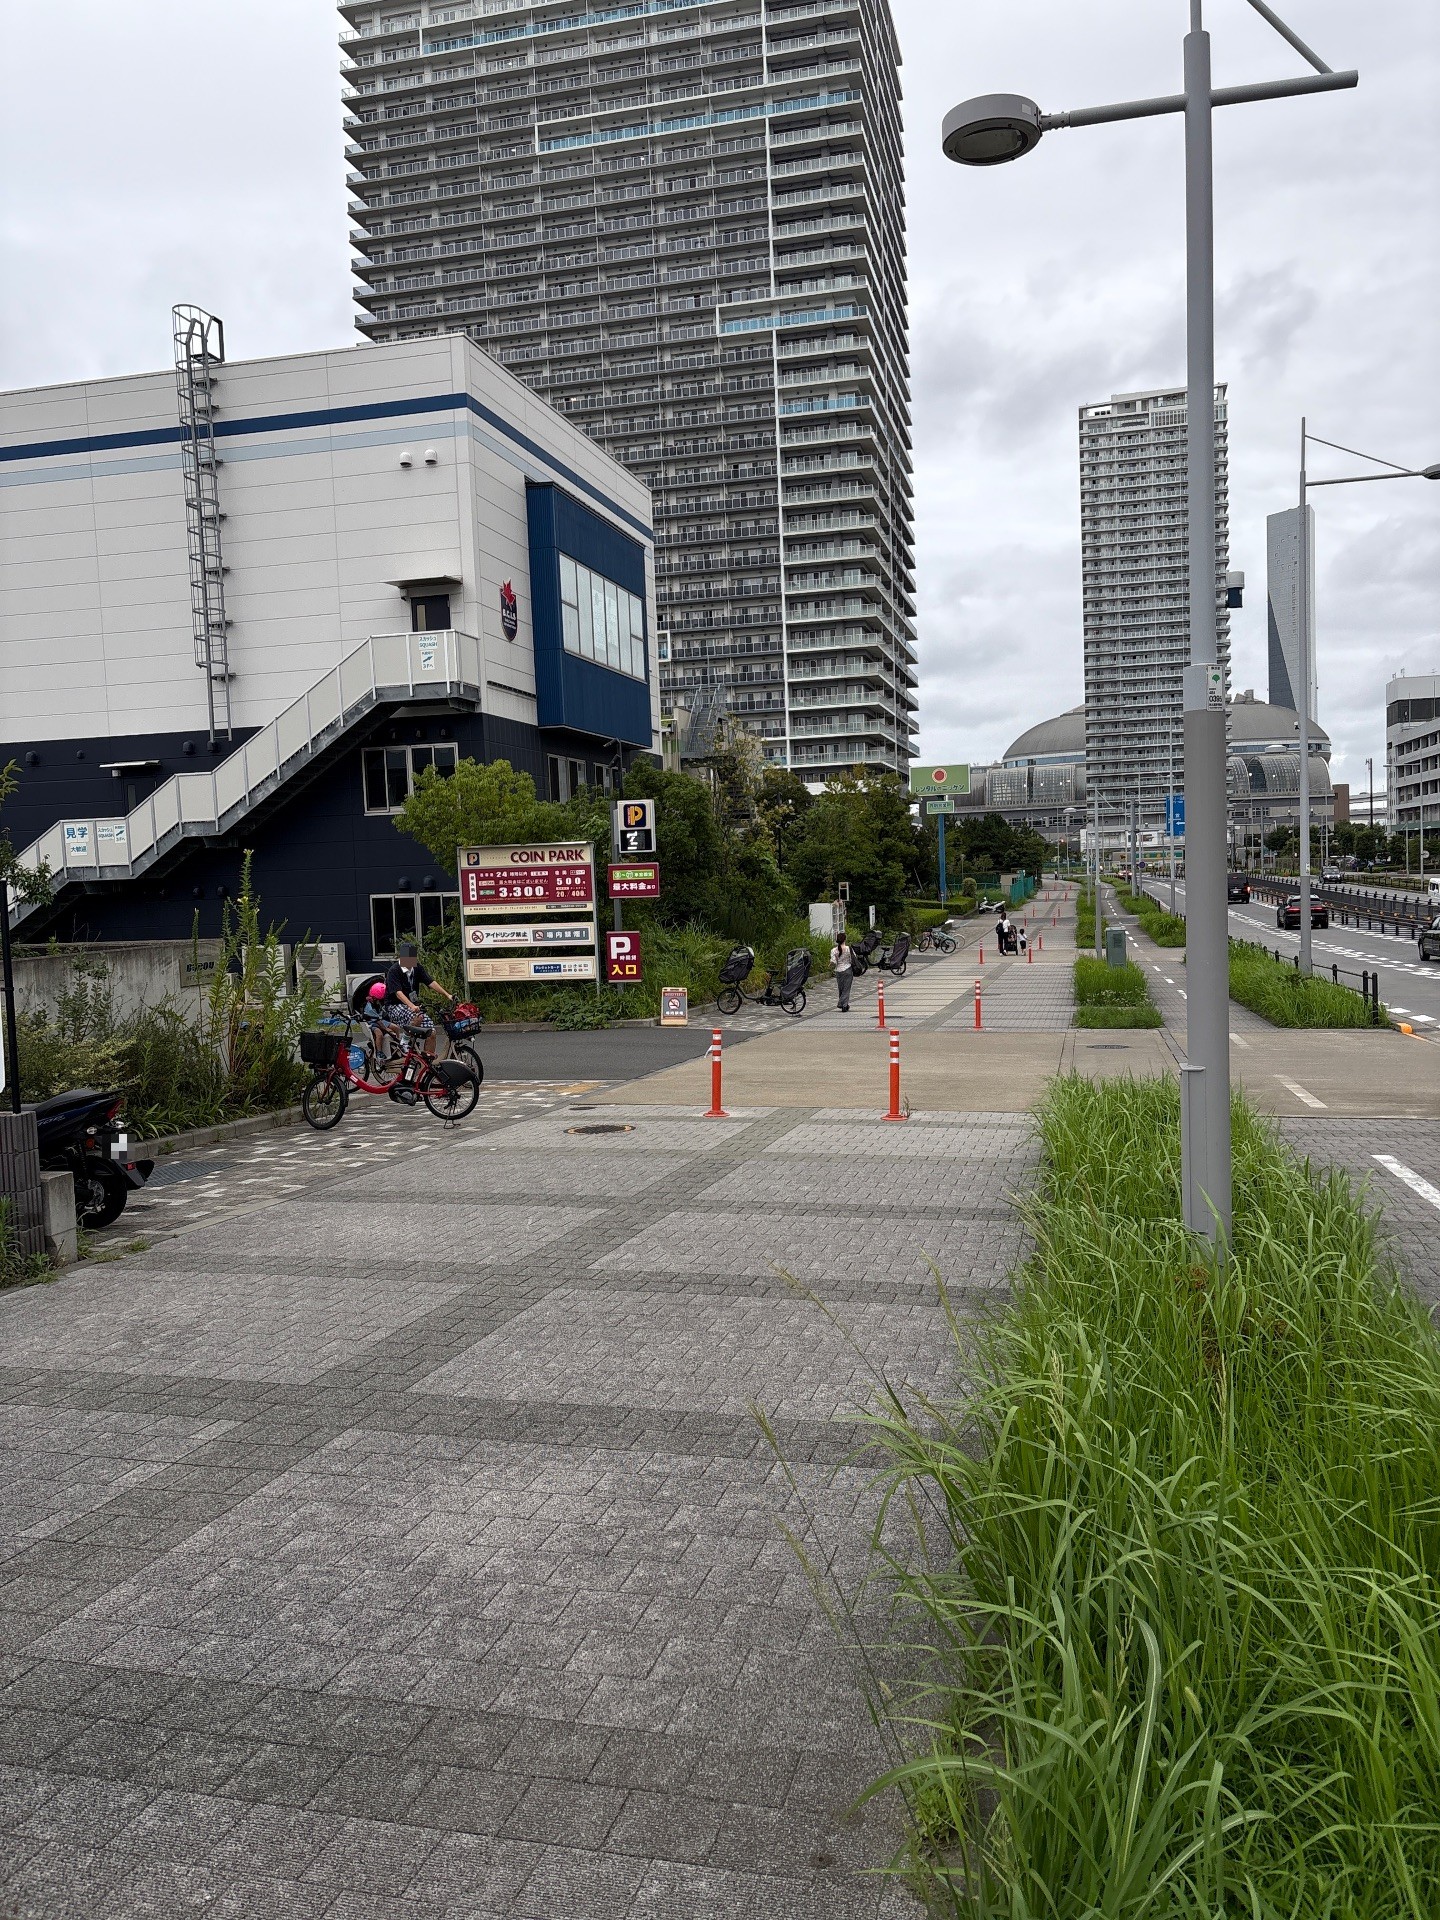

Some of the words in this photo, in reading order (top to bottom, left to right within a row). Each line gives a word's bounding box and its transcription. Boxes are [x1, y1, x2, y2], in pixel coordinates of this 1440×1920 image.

[915, 784, 965, 793] レンタルのニッケン
[66, 826, 88, 839] 見学
[510, 851, 545, 863] COIN
[549, 849, 585, 861] PARK
[612, 882, 656, 891] 最大料金あり
[485, 931, 528, 939] アイドリング禁止
[610, 936, 631, 960] P
[611, 964, 637, 976] 入口
